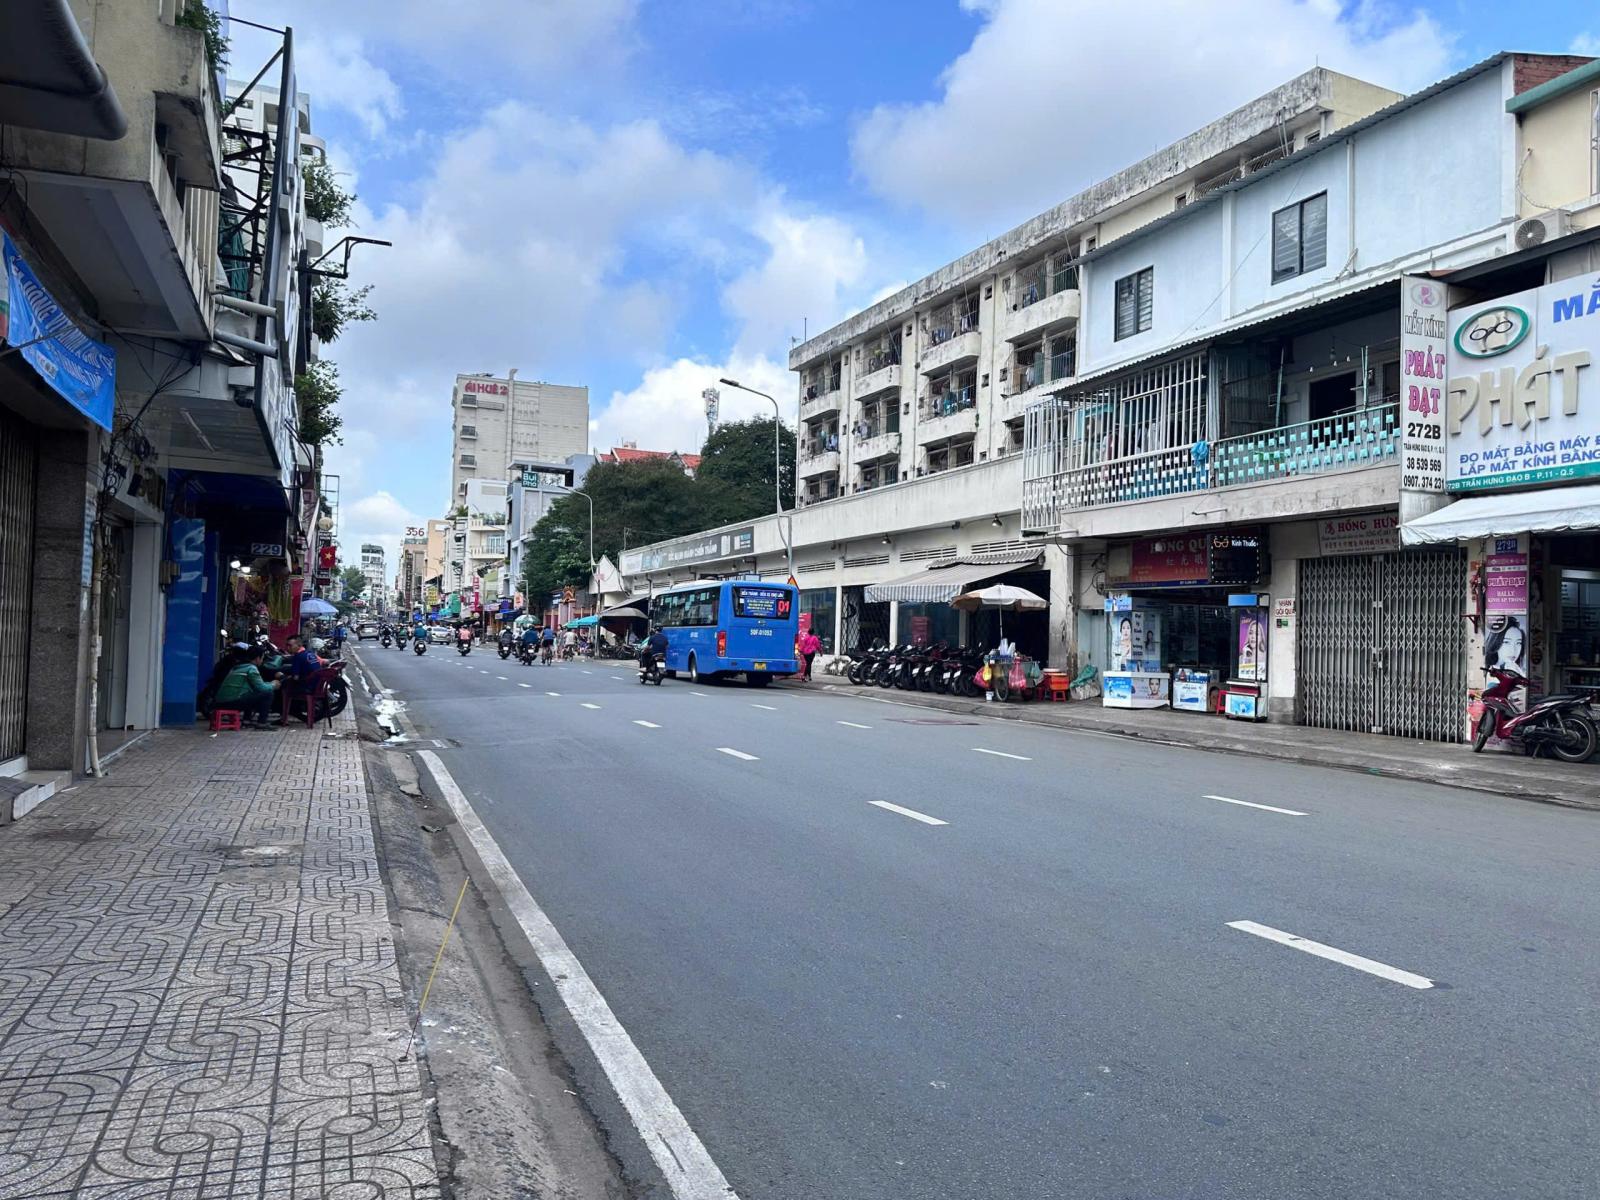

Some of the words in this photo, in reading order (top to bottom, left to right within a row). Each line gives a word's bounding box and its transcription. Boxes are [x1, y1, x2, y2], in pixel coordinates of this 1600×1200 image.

[1405, 309, 1423, 335] MẮT
[1424, 314, 1446, 339] KÍNH
[1405, 345, 1446, 379] PHÁT
[500, 385, 509, 396] 2
[1449, 344, 1591, 437] PHÁT
[1408, 385, 1441, 418] ĐẠT
[1408, 422, 1441, 440] 272B
[1460, 453, 1479, 464] ĐO
[1483, 445, 1510, 460] MẮT
[1514, 441, 1555, 456] BẰNG
[1560, 435, 1590, 450] MÁY
[1406, 457, 1415, 469] 38
[1416, 458, 1428, 471] 539
[1430, 459, 1442, 472] 569
[1460, 462, 1486, 476] LẮP
[1490, 458, 1518, 472] MẮT
[1523, 454, 1557, 469] KÍNH
[1421, 476, 1433, 488] 374
[1447, 482, 1460, 490] 72B
[1537, 471, 1553, 479] P.11
[1560, 468, 1574, 476] Q.5
[406, 527, 425, 536] 356
[252, 544, 280, 555] 229
[1488, 576, 1508, 587] PHÁT
[778, 600, 790, 612] 01
